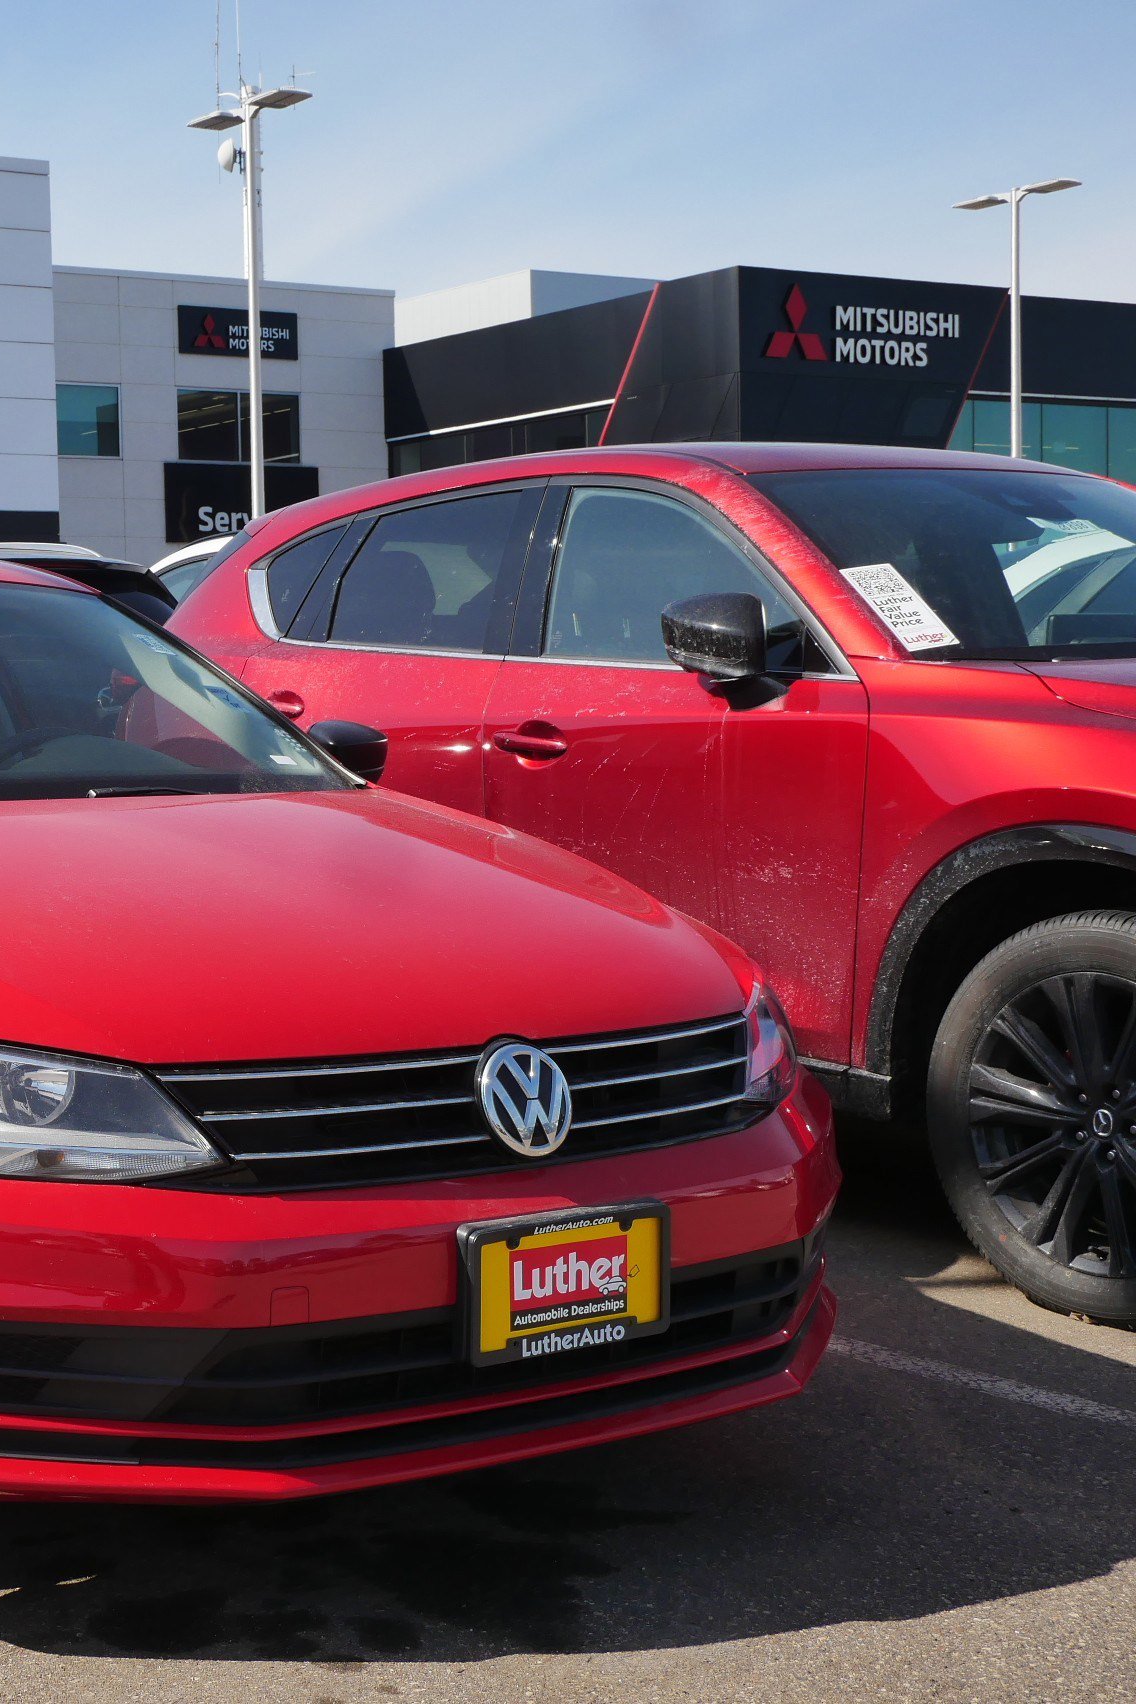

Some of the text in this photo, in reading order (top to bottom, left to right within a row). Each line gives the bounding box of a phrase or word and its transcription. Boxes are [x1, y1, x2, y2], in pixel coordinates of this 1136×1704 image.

[835, 305, 960, 338] MITSUBISHI
[228, 324, 290, 340] MITBISHI
[228, 338, 275, 352] MORS
[835, 337, 928, 367] MOTORS
[873, 595, 914, 608] Luther
[879, 604, 902, 614] Fair
[884, 611, 921, 621] Value
[891, 618, 924, 628] Price
[903, 632, 945, 645] Luther
[533, 1216, 614, 1235] LutherAuto.com
[513, 1251, 625, 1301] Luther
[514, 1299, 625, 1326] Automobile Dealerships
[521, 1323, 626, 1358] LutherAuto
